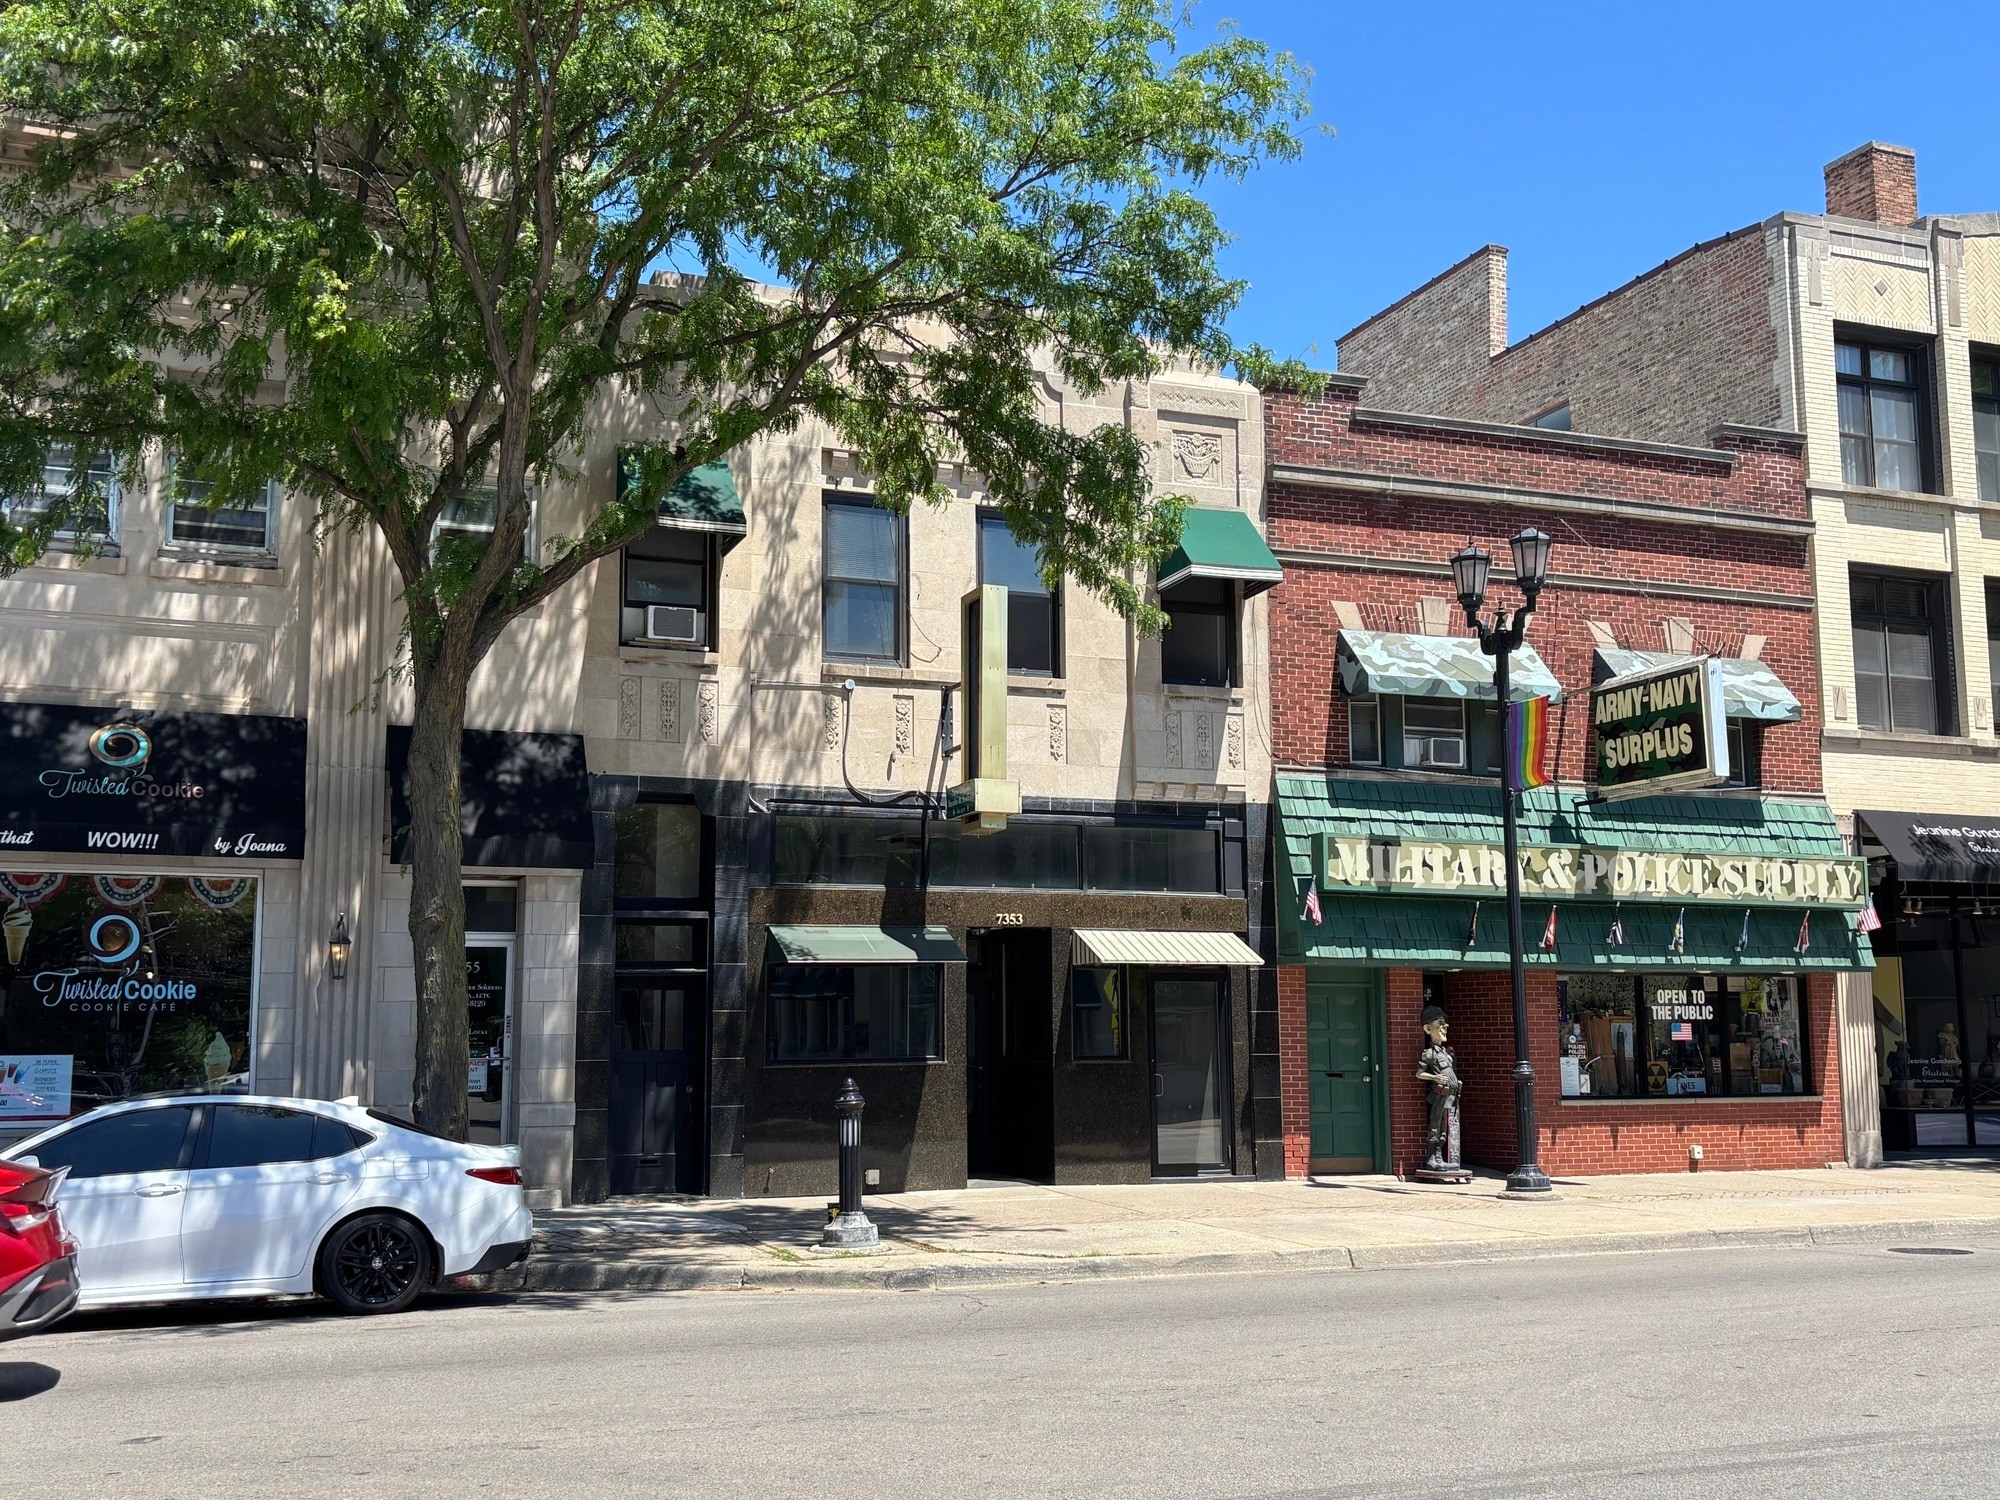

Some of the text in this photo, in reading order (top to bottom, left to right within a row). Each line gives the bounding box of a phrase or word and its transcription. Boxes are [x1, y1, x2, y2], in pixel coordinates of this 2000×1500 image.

[1595, 671, 1698, 725] ARMY-NAVY
[1605, 722, 1693, 769] SURPLUS
[38, 768, 205, 799] Twisted Cookie
[0, 830, 35, 845] that
[1912, 824, 1962, 836] Jeanine
[87, 831, 160, 850] WOW!!!
[214, 833, 287, 856] by Joana
[1542, 848, 1576, 889] &
[1582, 853, 1714, 895] POLICE
[1719, 858, 1862, 900] SUPPLY
[996, 913, 1023, 925] 7353
[33, 968, 197, 1007] Twisted Cookie
[1657, 989, 1705, 1004] OPEN TO
[138, 1002, 176, 1012] CAFÉ
[1651, 1005, 1714, 1020] THE PUBLIC
[1907, 1057, 1929, 1065] Jeanine
